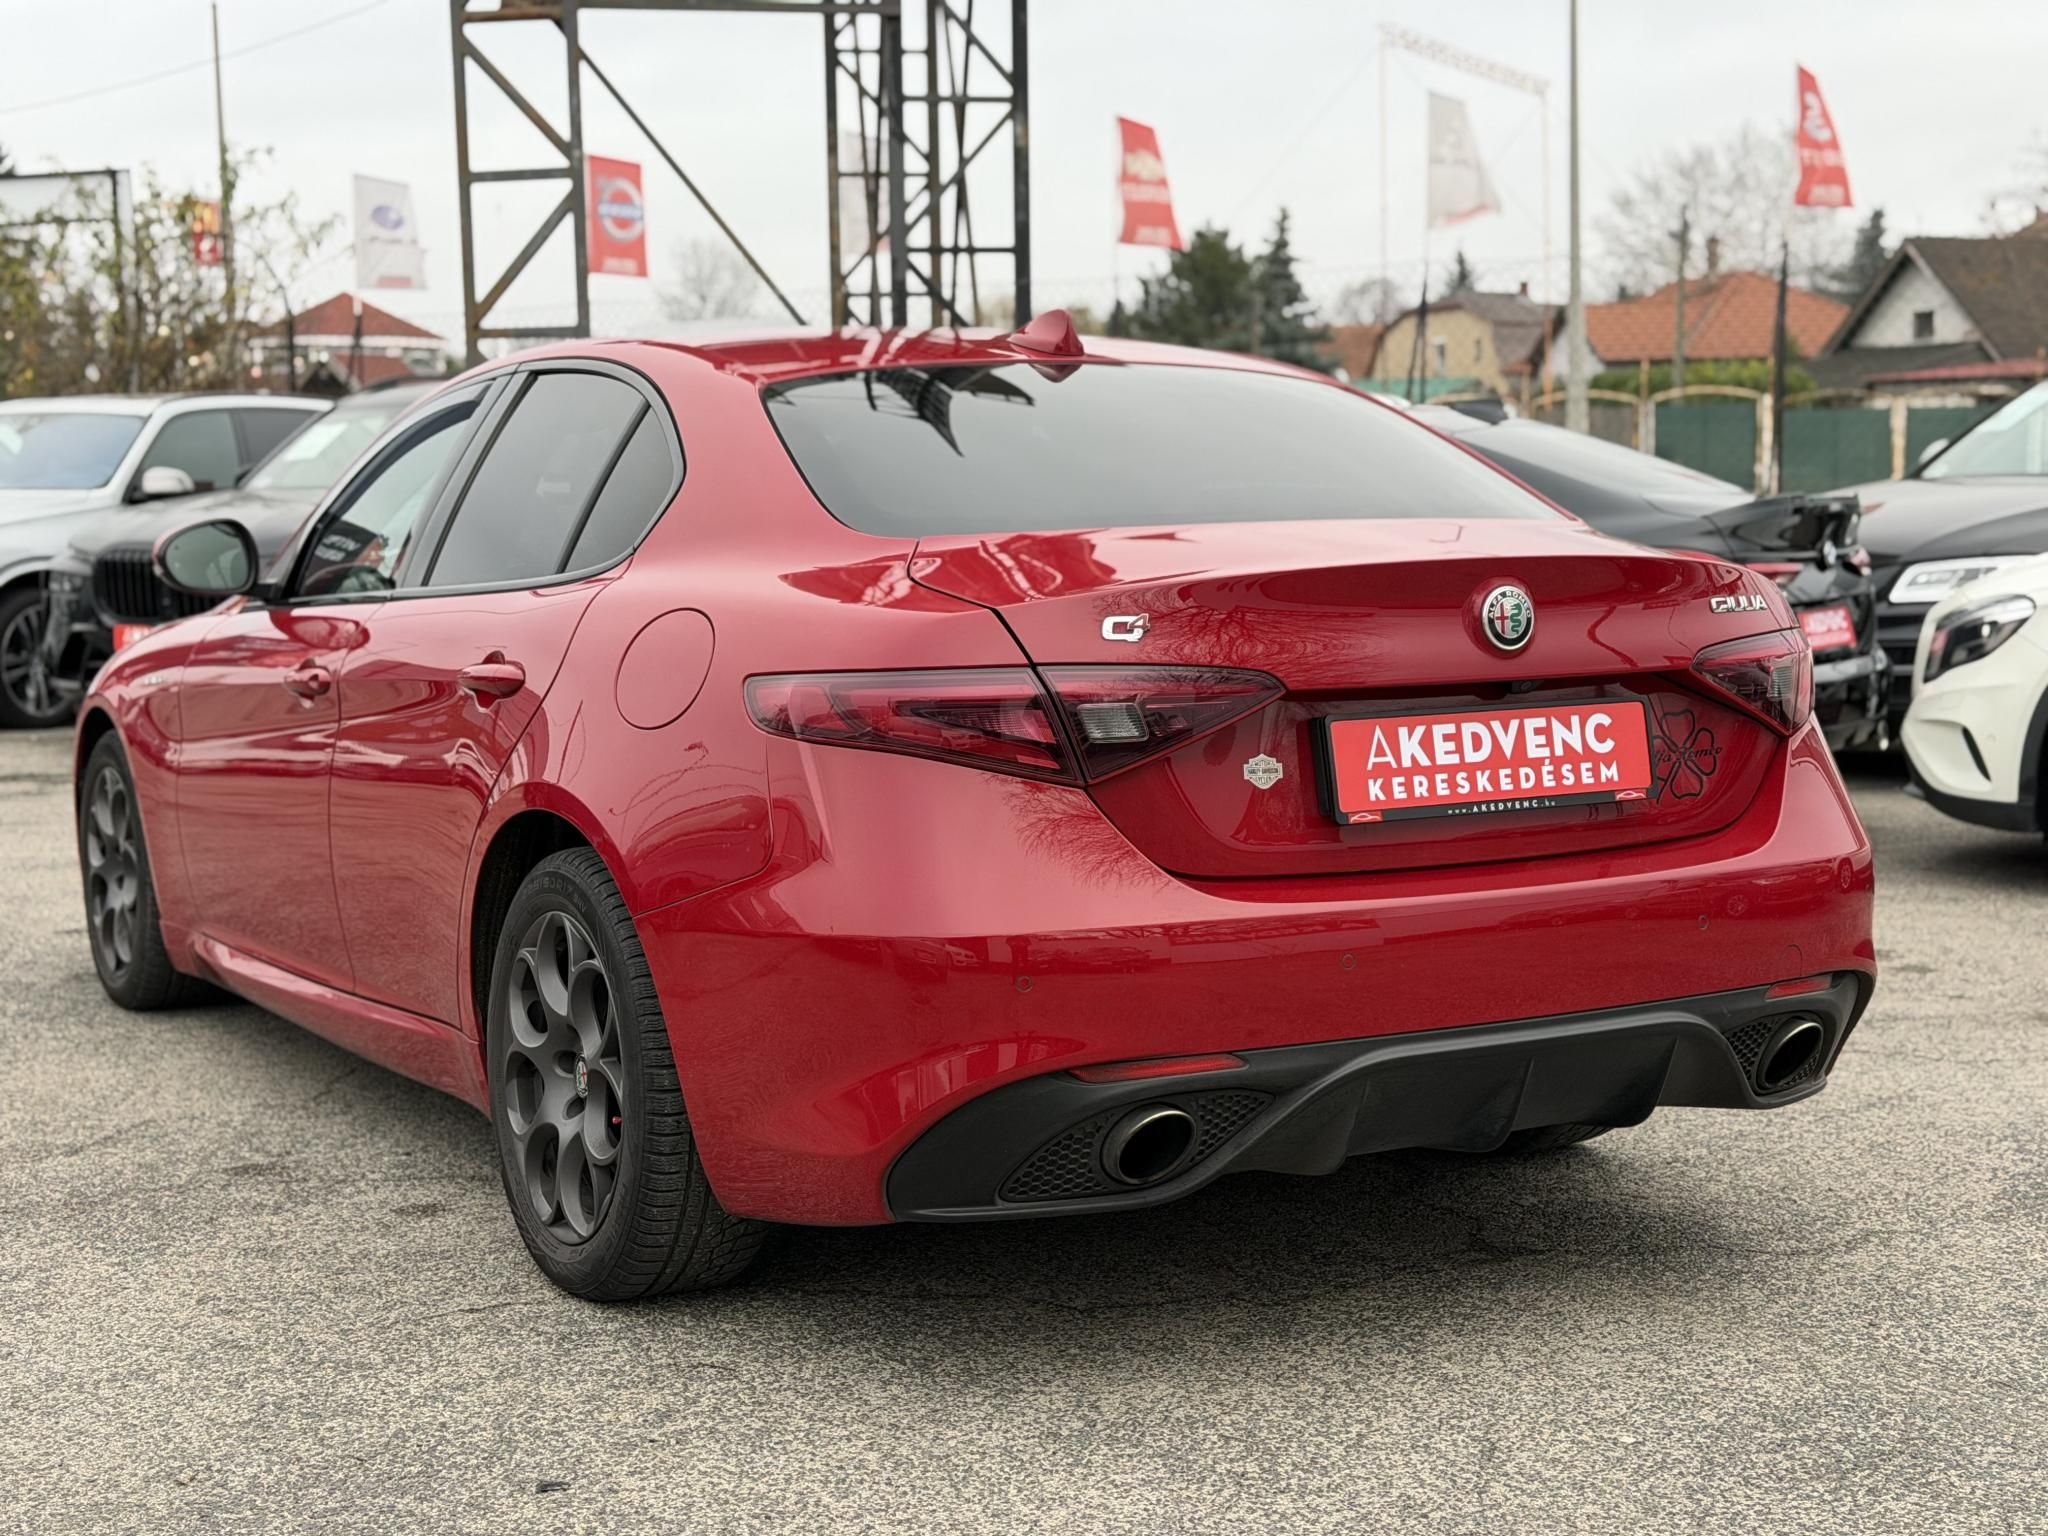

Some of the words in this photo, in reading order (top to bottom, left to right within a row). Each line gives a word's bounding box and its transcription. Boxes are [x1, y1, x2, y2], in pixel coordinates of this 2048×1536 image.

[1488, 594, 1503, 618] ALFA
[1505, 590, 1531, 618] ROMEO
[1367, 759, 1620, 801] KERESKEDÉSEM
